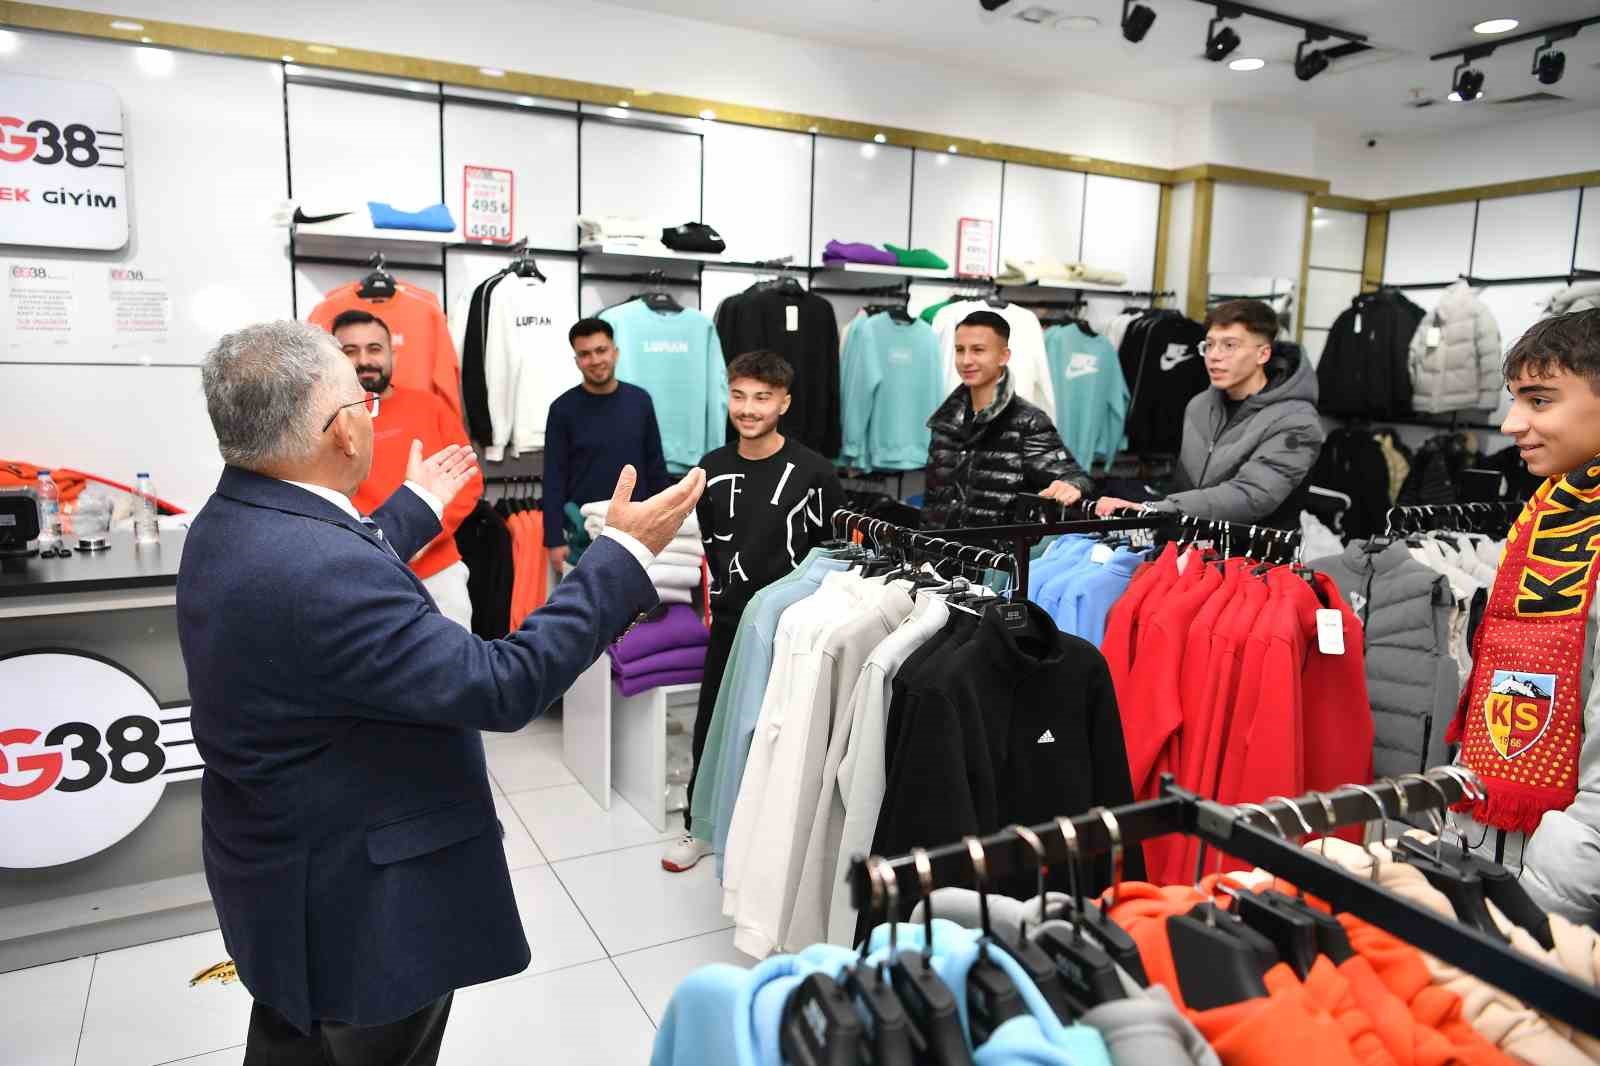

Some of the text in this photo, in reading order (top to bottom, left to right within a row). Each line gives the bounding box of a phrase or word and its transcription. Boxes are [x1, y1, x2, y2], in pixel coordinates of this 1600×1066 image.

[0, 116, 100, 168] G38
[42, 187, 117, 208] GİYİM
[1491, 701, 1539, 731] KS
[0, 715, 166, 800] G38
